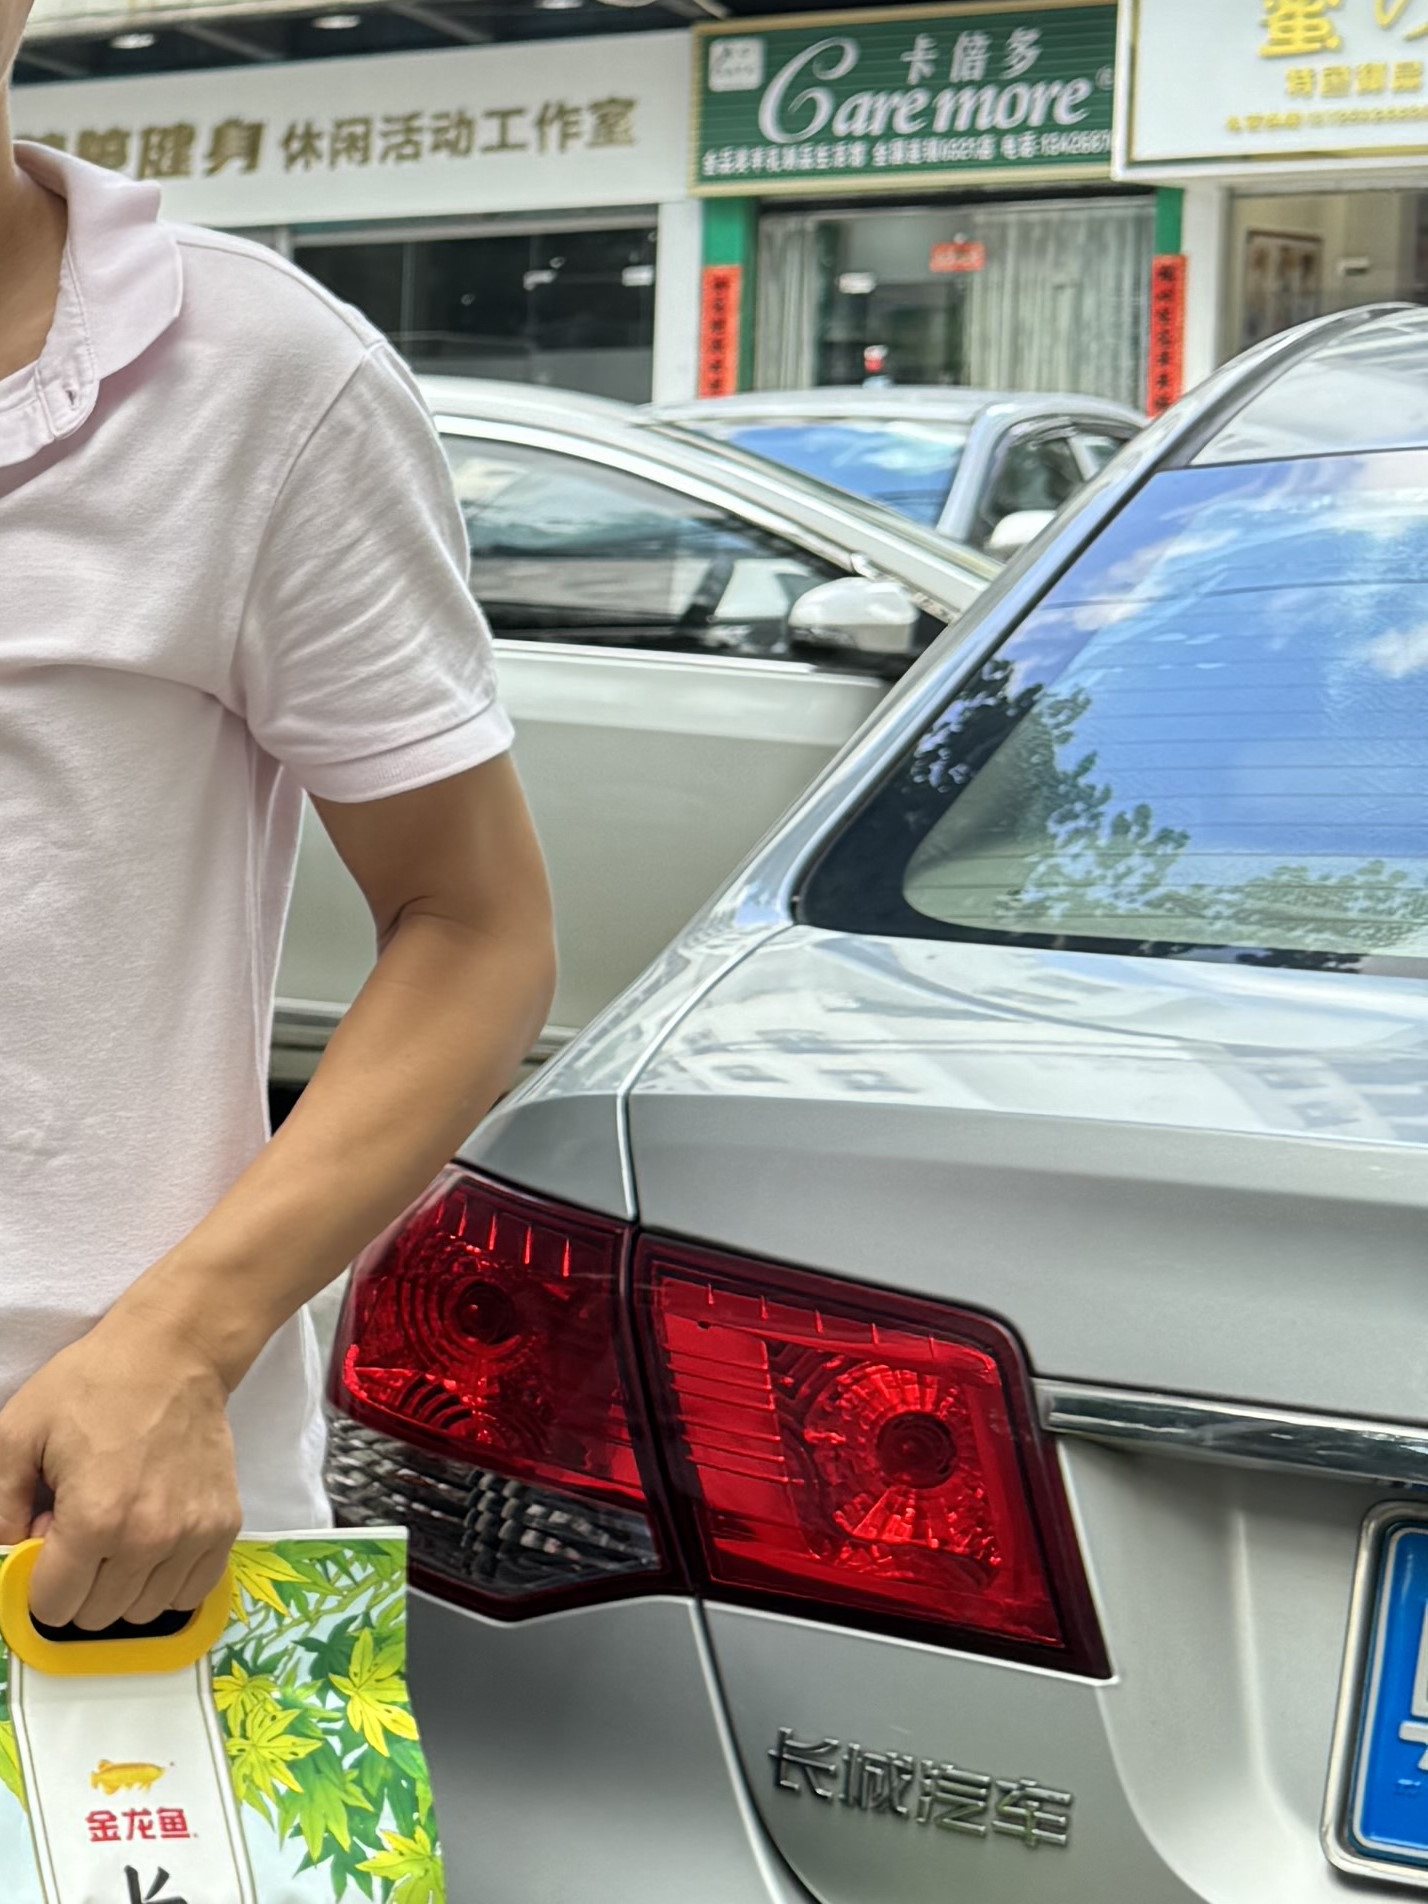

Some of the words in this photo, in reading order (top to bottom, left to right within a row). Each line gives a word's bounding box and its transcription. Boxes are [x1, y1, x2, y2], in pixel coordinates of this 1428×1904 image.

[901, 27, 1042, 85] 卡倍多
[281, 96, 638, 173] 休闲活动工作室
[767, 1727, 1073, 1849] 长城汽车
[85, 1807, 191, 1843] 金龙鱼
